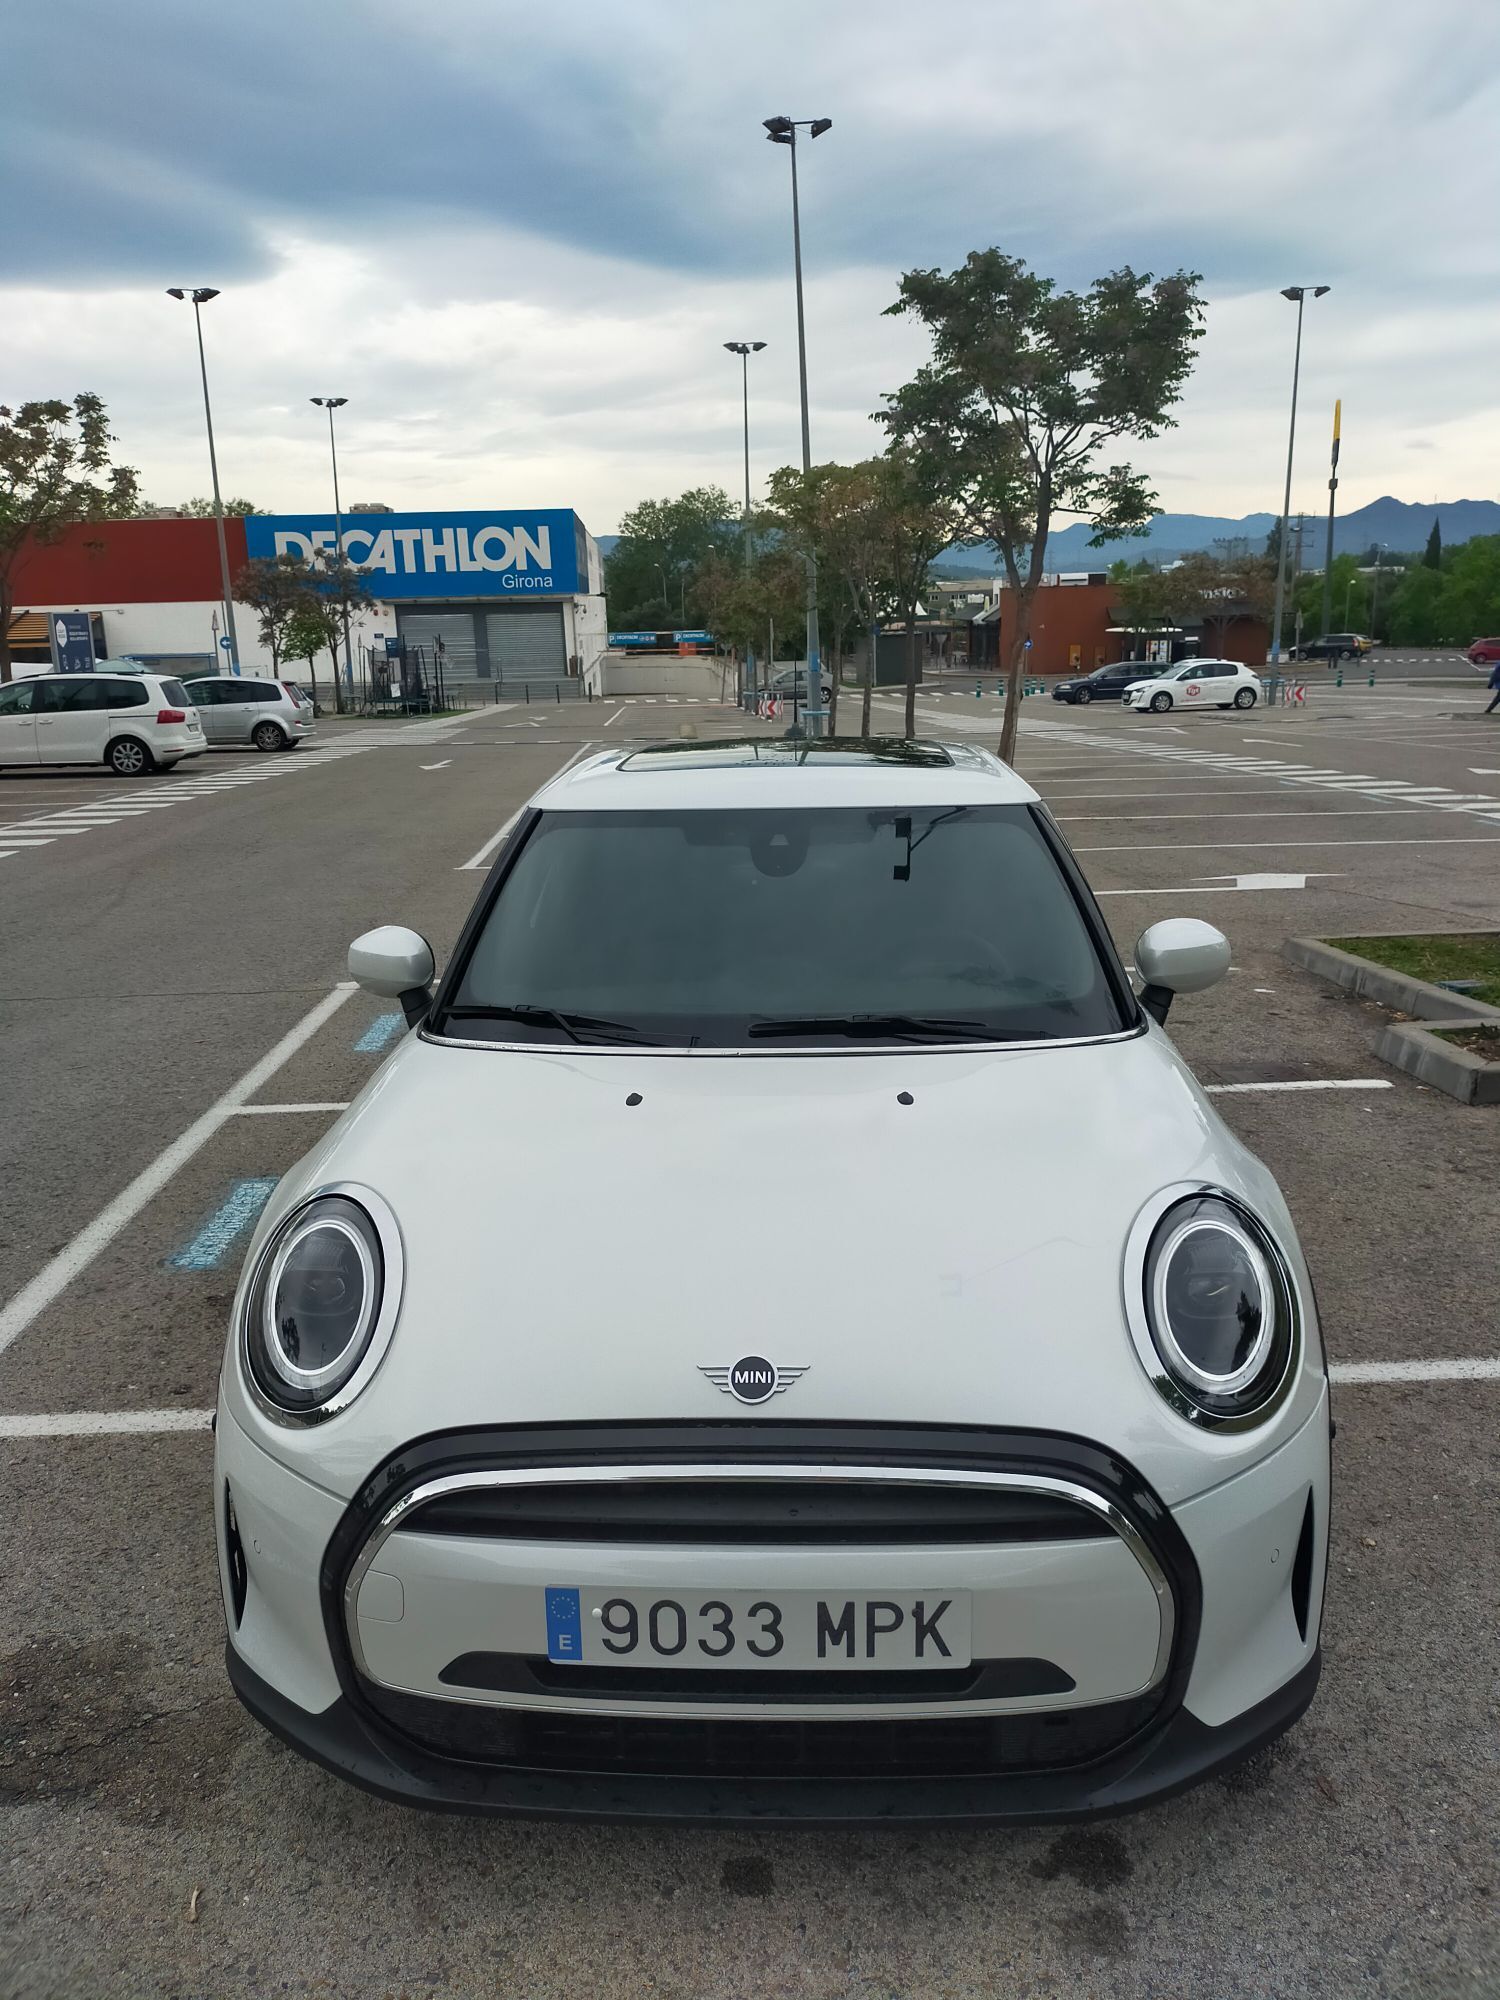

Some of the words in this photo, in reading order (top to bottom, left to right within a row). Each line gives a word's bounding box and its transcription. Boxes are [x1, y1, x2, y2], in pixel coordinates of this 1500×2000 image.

[502, 574, 553, 588] Girona
[734, 1370, 772, 1384] MINI
[601, 1598, 784, 1658] 9033
[816, 1600, 953, 1658] MPK
[559, 1634, 573, 1650] E
